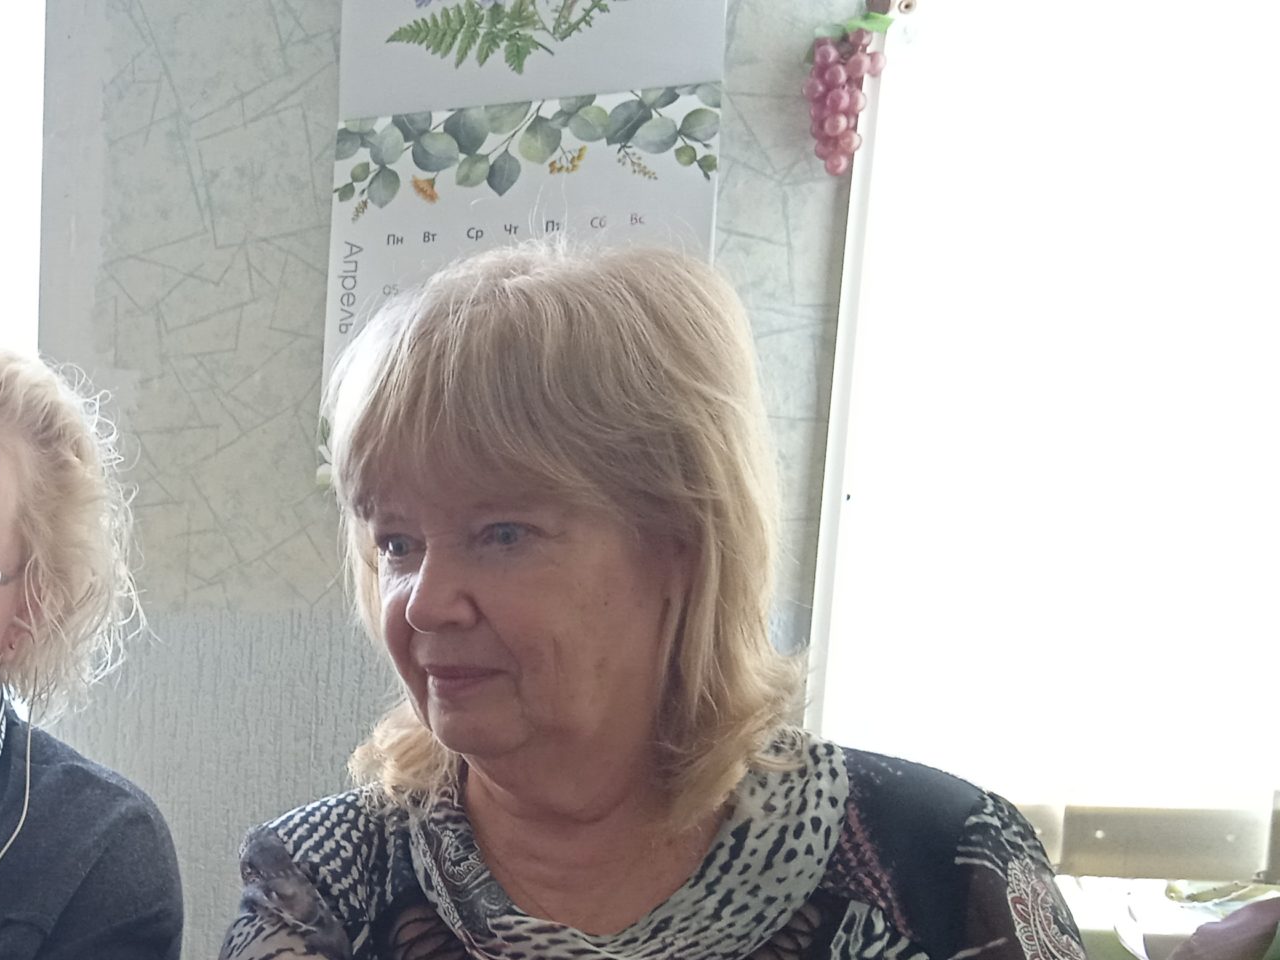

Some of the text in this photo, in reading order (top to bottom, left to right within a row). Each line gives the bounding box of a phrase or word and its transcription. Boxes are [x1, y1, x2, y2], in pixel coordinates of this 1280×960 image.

[386, 233, 404, 246] Пн
[422, 231, 437, 243] Вт
[466, 227, 484, 241] Ср
[504, 223, 519, 235] Чт
[590, 215, 607, 229] Сб
[630, 213, 645, 226] Вс
[337, 240, 364, 335] Апрель
